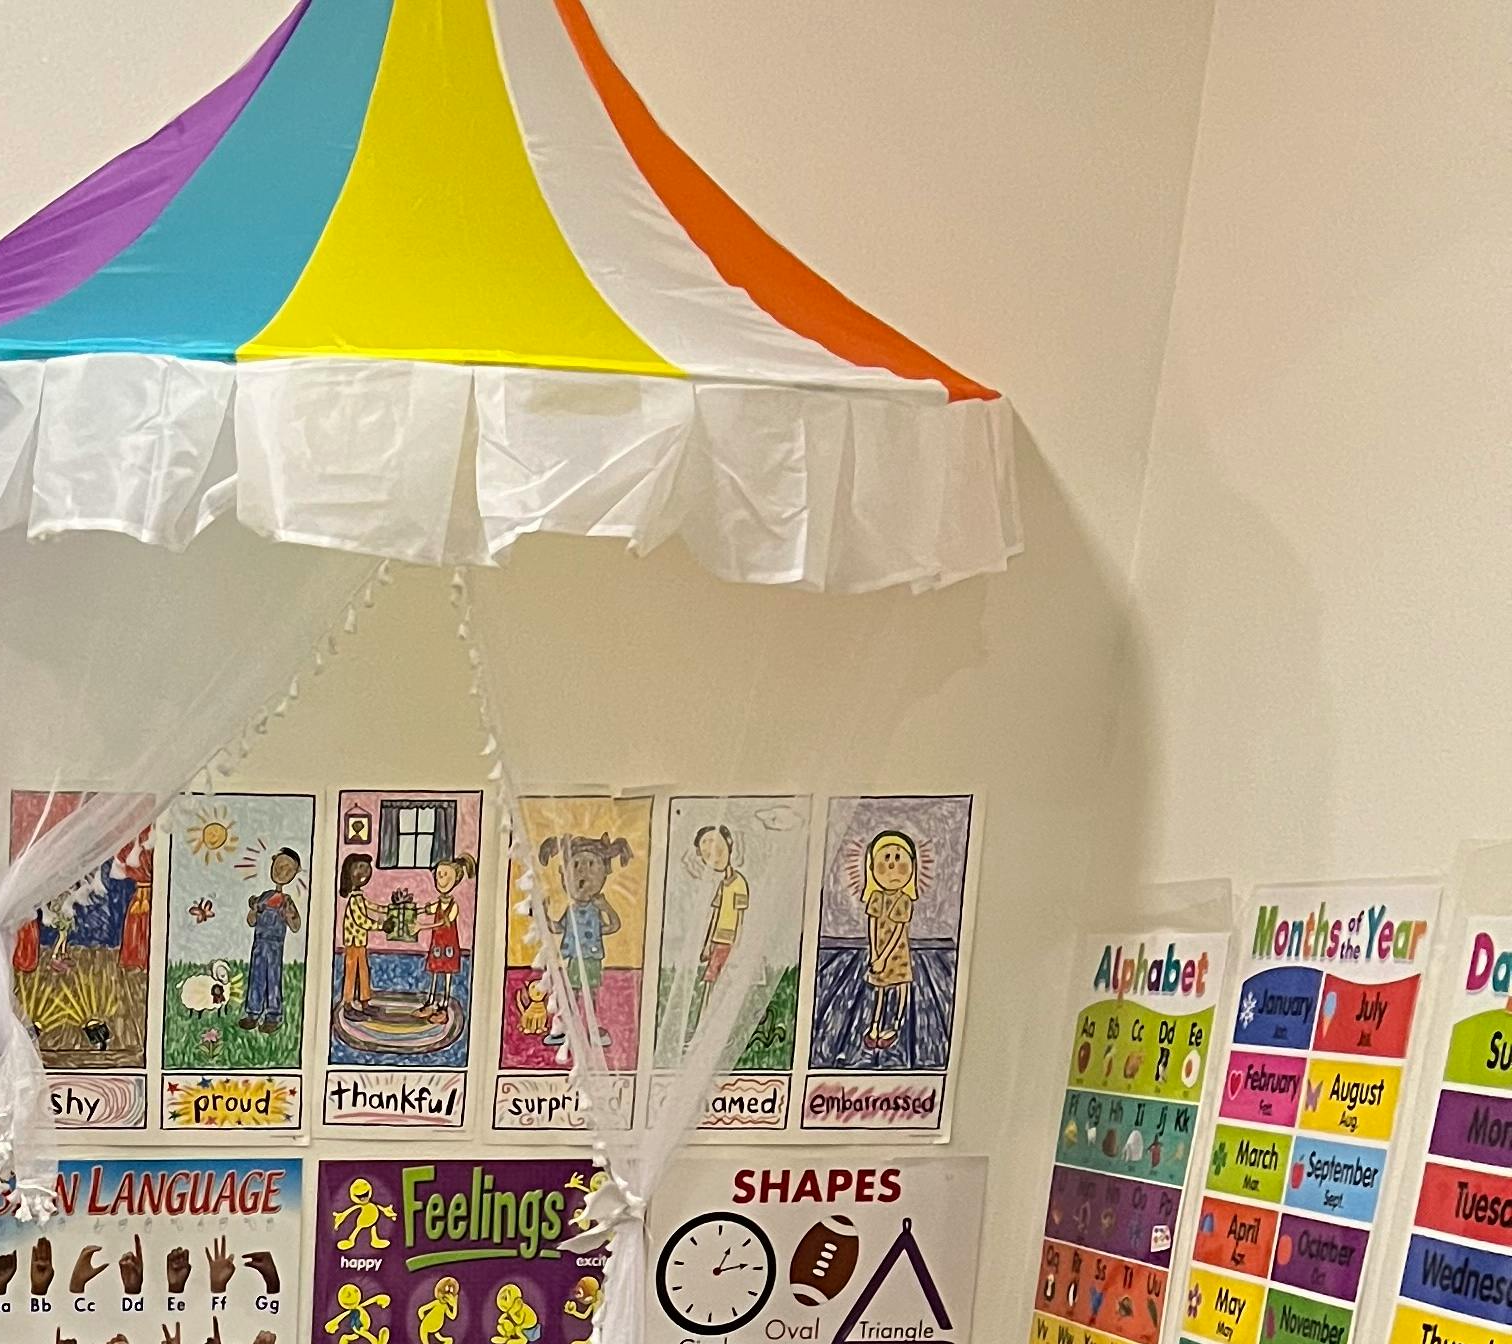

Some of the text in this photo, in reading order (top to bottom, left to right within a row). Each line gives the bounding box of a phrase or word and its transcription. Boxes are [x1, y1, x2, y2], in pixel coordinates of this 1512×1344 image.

[1251, 901, 1428, 961] Months of the Year
[1093, 943, 1209, 1001] Alphabet
[1258, 989, 1313, 1024] January
[1355, 991, 1388, 1030] July
[1158, 1020, 1204, 1047] Dd Ee
[331, 1081, 457, 1117] thankful
[1244, 1063, 1300, 1102] February
[1329, 1073, 1385, 1111] August
[51, 1083, 101, 1122] shy
[193, 1085, 271, 1124] proud
[809, 1088, 937, 1116] embarrassed
[1235, 1139, 1279, 1172] March
[1306, 1150, 1379, 1189] September
[88, 1166, 286, 1216] LANGUAGE
[732, 1168, 902, 1203] SHAPES
[401, 1165, 565, 1259] Feelings
[1227, 1213, 1261, 1250] April
[1297, 1230, 1356, 1266] October
[340, 1256, 383, 1271] happy
[30, 1297, 52, 1313] Bb
[74, 1297, 97, 1313] Cc
[121, 1297, 145, 1313] Dd
[167, 1297, 186, 1312] Ee
[211, 1296, 227, 1311] Ff
[255, 1295, 280, 1314] Gg
[1214, 1286, 1247, 1324] May
[764, 1318, 821, 1341] Oval
[859, 1319, 934, 1342] Triangle
